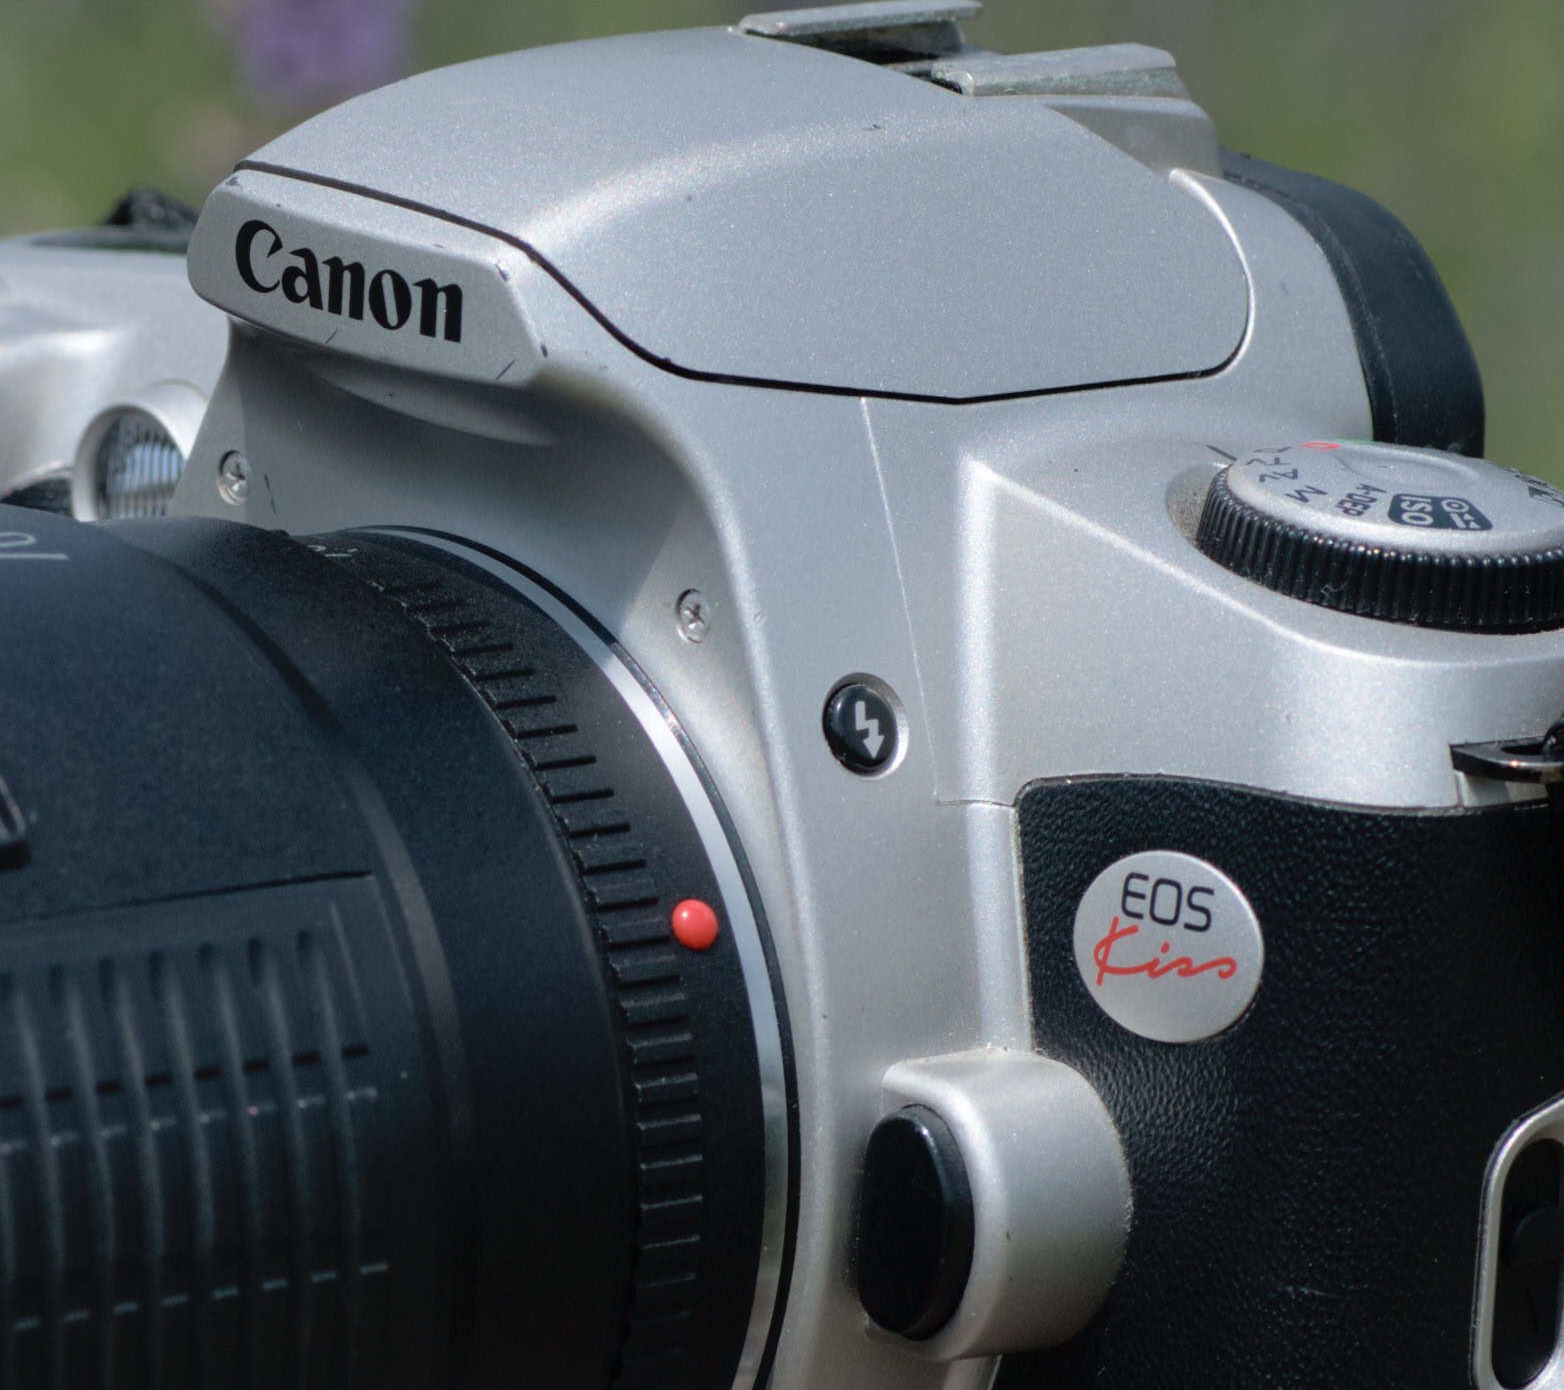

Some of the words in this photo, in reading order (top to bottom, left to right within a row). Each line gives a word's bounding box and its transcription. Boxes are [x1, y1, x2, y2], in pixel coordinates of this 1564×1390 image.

[234, 219, 463, 343] Canon
[1284, 484, 1328, 503] M
[1335, 482, 1387, 517] A-DEP
[1400, 495, 1434, 526] ISO
[1121, 871, 1215, 933] EOS
[1093, 915, 1238, 987] Kiss
